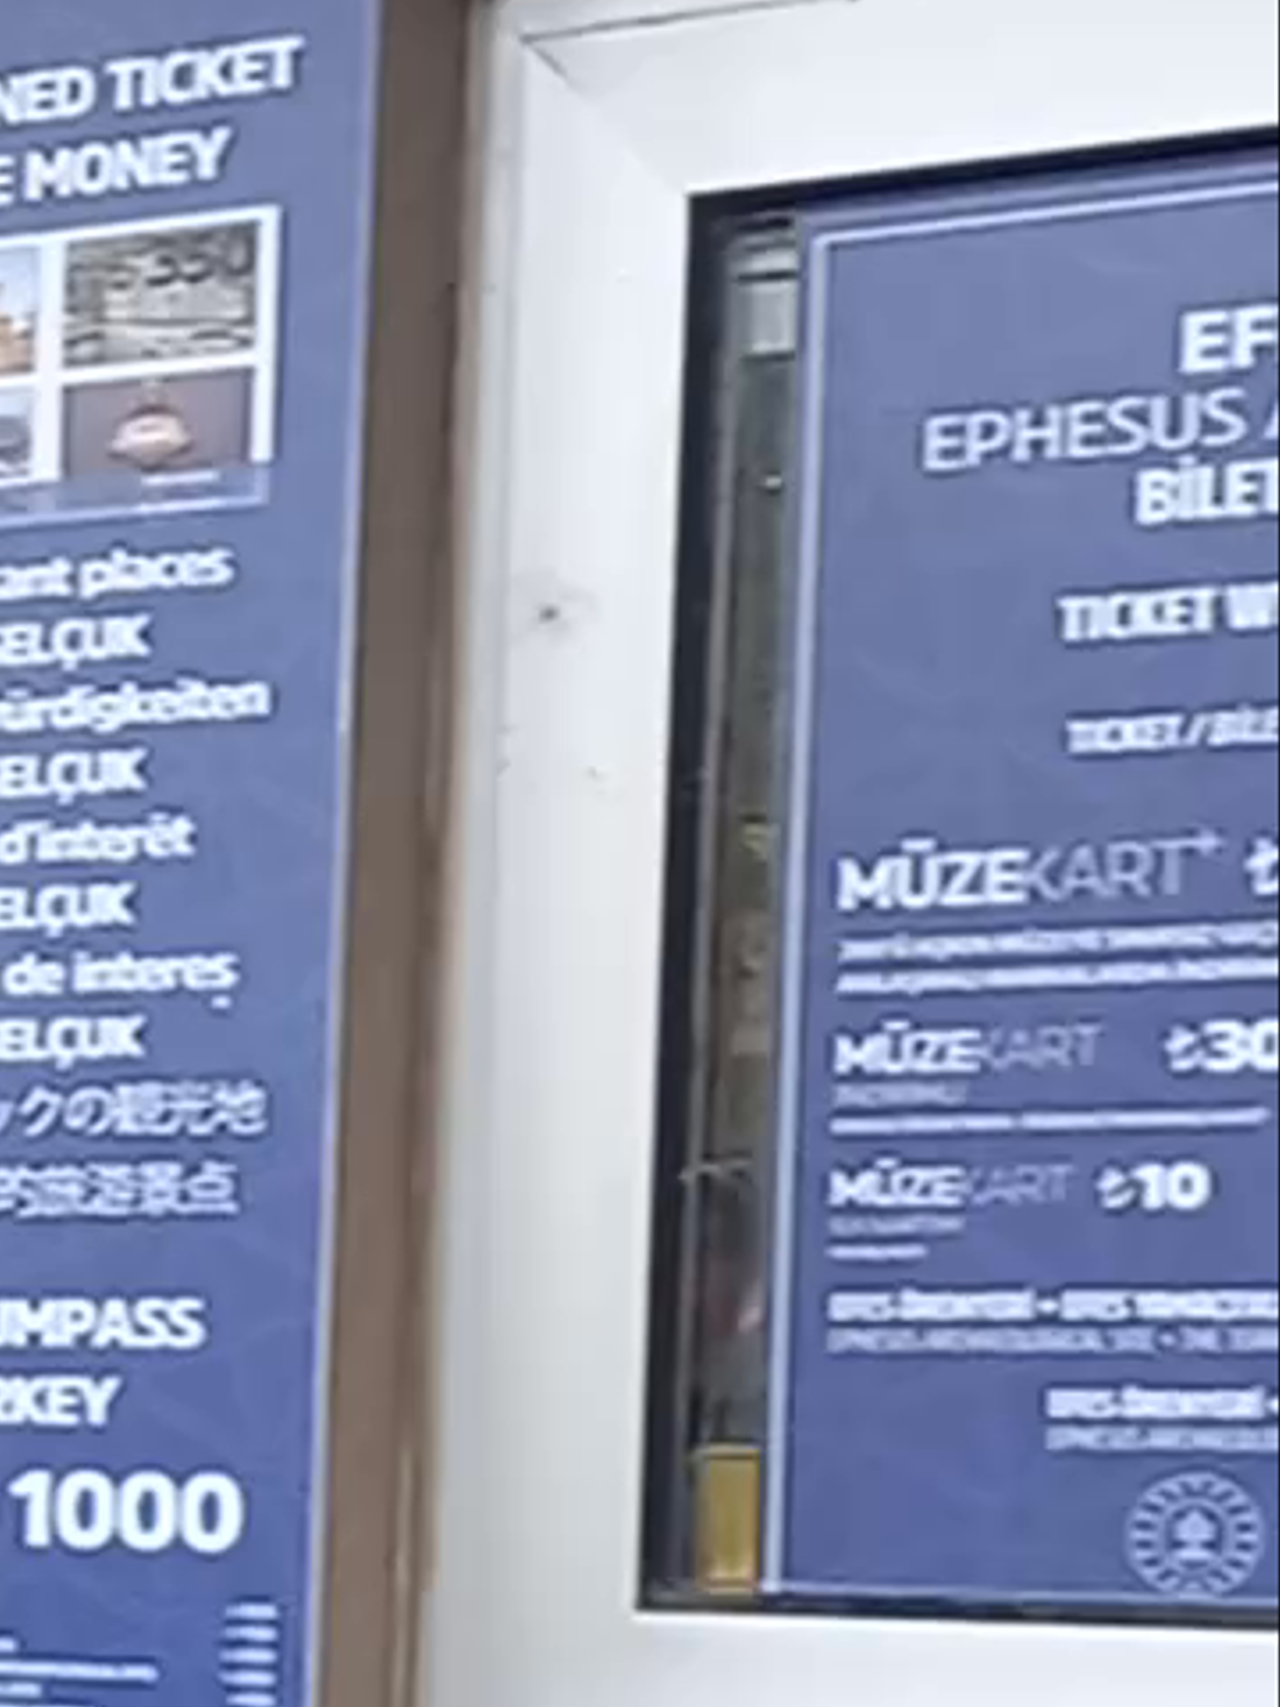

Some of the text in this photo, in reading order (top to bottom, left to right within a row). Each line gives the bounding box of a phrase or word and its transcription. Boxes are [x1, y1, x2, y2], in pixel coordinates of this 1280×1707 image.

[104, 36, 305, 111] TICKET
[24, 125, 231, 203] MONEY
[922, 386, 1246, 471] EPHESUS
[78, 548, 235, 598] places
[1056, 587, 1214, 643] TICKET
[2, 953, 66, 995] de
[7, 1470, 244, 1553] 1000
